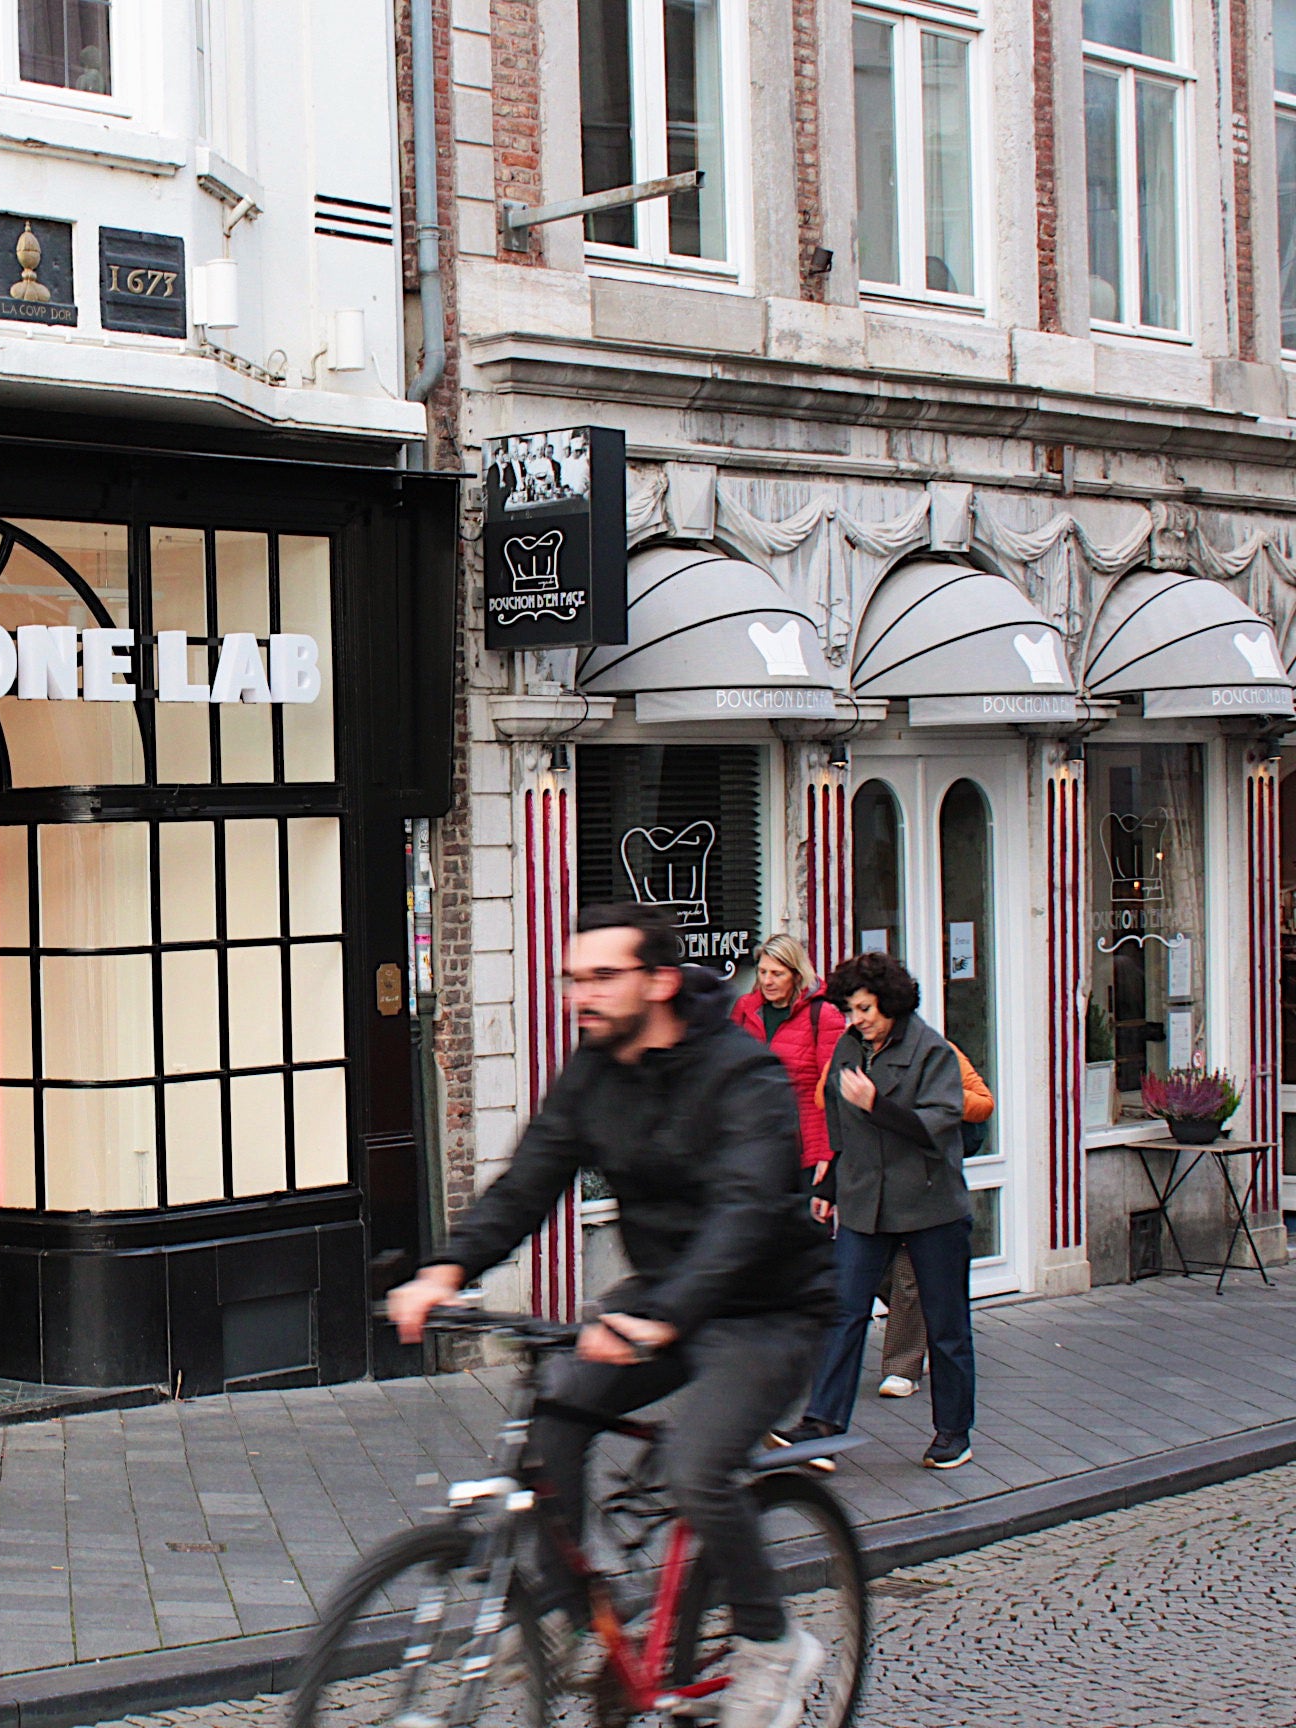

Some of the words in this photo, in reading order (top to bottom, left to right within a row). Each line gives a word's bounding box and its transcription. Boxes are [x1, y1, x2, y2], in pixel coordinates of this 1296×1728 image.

[108, 265, 178, 297] 1673
[1, 302, 17, 315] LA
[488, 594, 536, 612] BOUCHON
[157, 629, 322, 704] LAB
[716, 689, 793, 708] BOUCHON
[983, 696, 1050, 713] BOUCHON
[1211, 688, 1273, 706] BOUCHON
[1085, 909, 1138, 932] OUCHON
